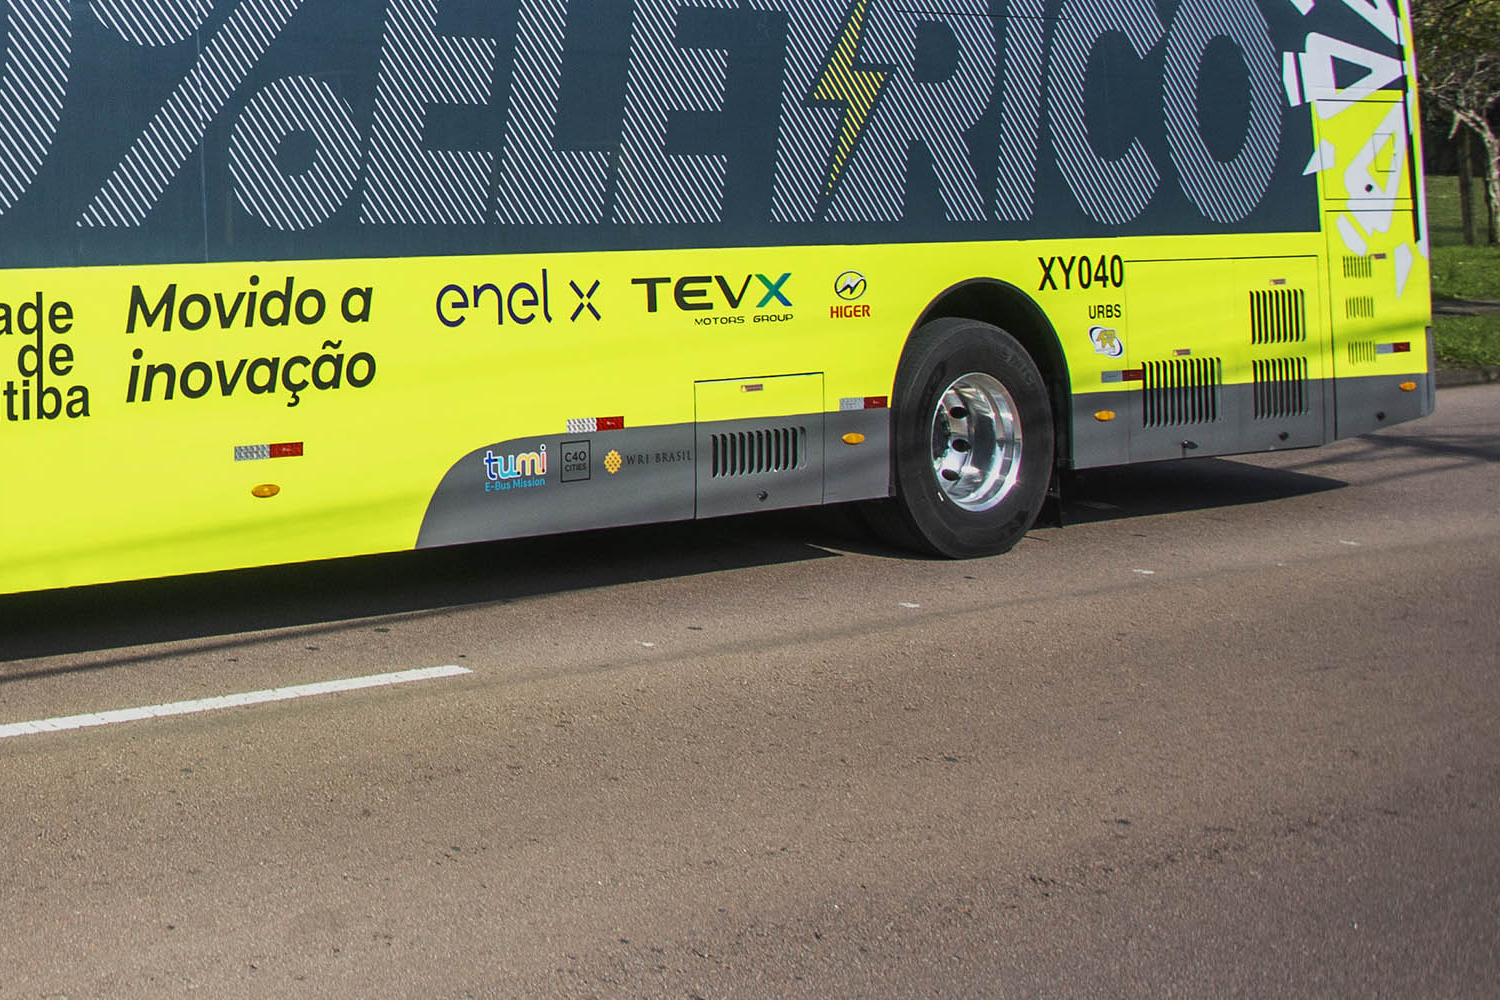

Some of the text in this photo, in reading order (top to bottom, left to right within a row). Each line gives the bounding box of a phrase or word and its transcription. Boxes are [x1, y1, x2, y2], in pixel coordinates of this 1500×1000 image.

[1037, 254, 1124, 291] XY040
[125, 275, 373, 335] Movido a
[436, 268, 553, 328] enel
[631, 272, 793, 313] TEVX
[695, 313, 794, 326] MOTORS GROUP
[830, 305, 871, 319] HIGER
[1088, 304, 1122, 319] URBS
[18, 342, 74, 378] de
[126, 340, 376, 408] inovação
[484, 443, 548, 481] tumi
[564, 451, 587, 463] C40
[564, 463, 587, 472] CITIES
[626, 450, 693, 465] WRI BRASIL
[485, 477, 546, 492] E-Bus Mission
